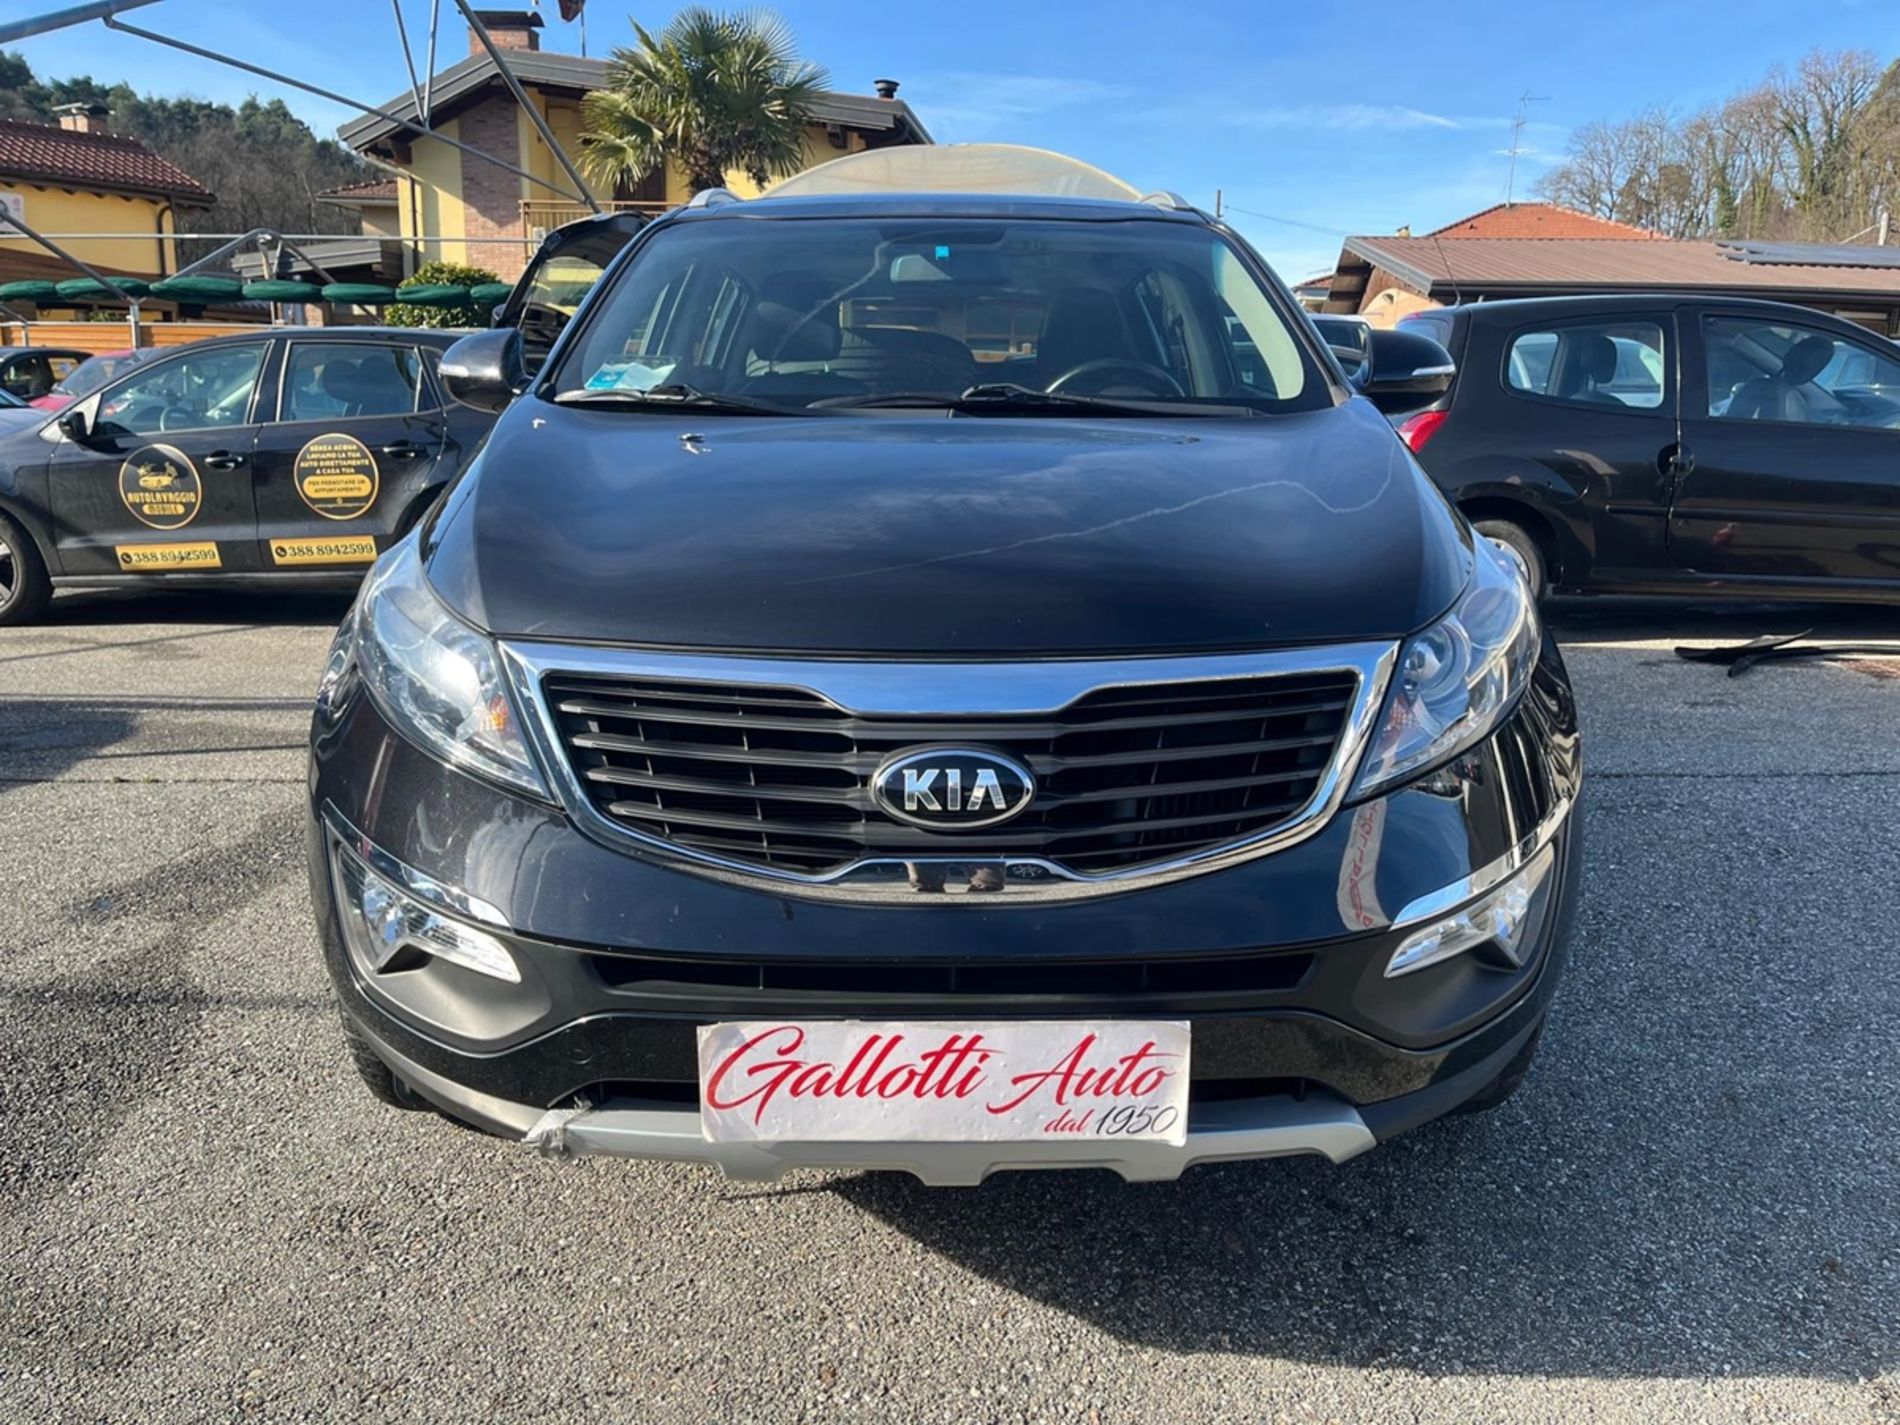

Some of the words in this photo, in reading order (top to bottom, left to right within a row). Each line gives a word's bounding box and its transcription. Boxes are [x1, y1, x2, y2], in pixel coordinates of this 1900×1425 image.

[320, 459, 369, 467] DIRETTAMENTE
[127, 492, 196, 503] AUTOLAVAGGIO
[133, 551, 159, 563] 388
[161, 549, 216, 563] 8942599
[288, 545, 314, 557] 388
[316, 543, 373, 556] 8942599
[902, 769, 1007, 811] KIA
[707, 1025, 1005, 1126] Gallotti
[985, 1033, 1185, 1114] Auto
[1043, 1107, 1095, 1134] dal
[1095, 1104, 1178, 1135] 1950
